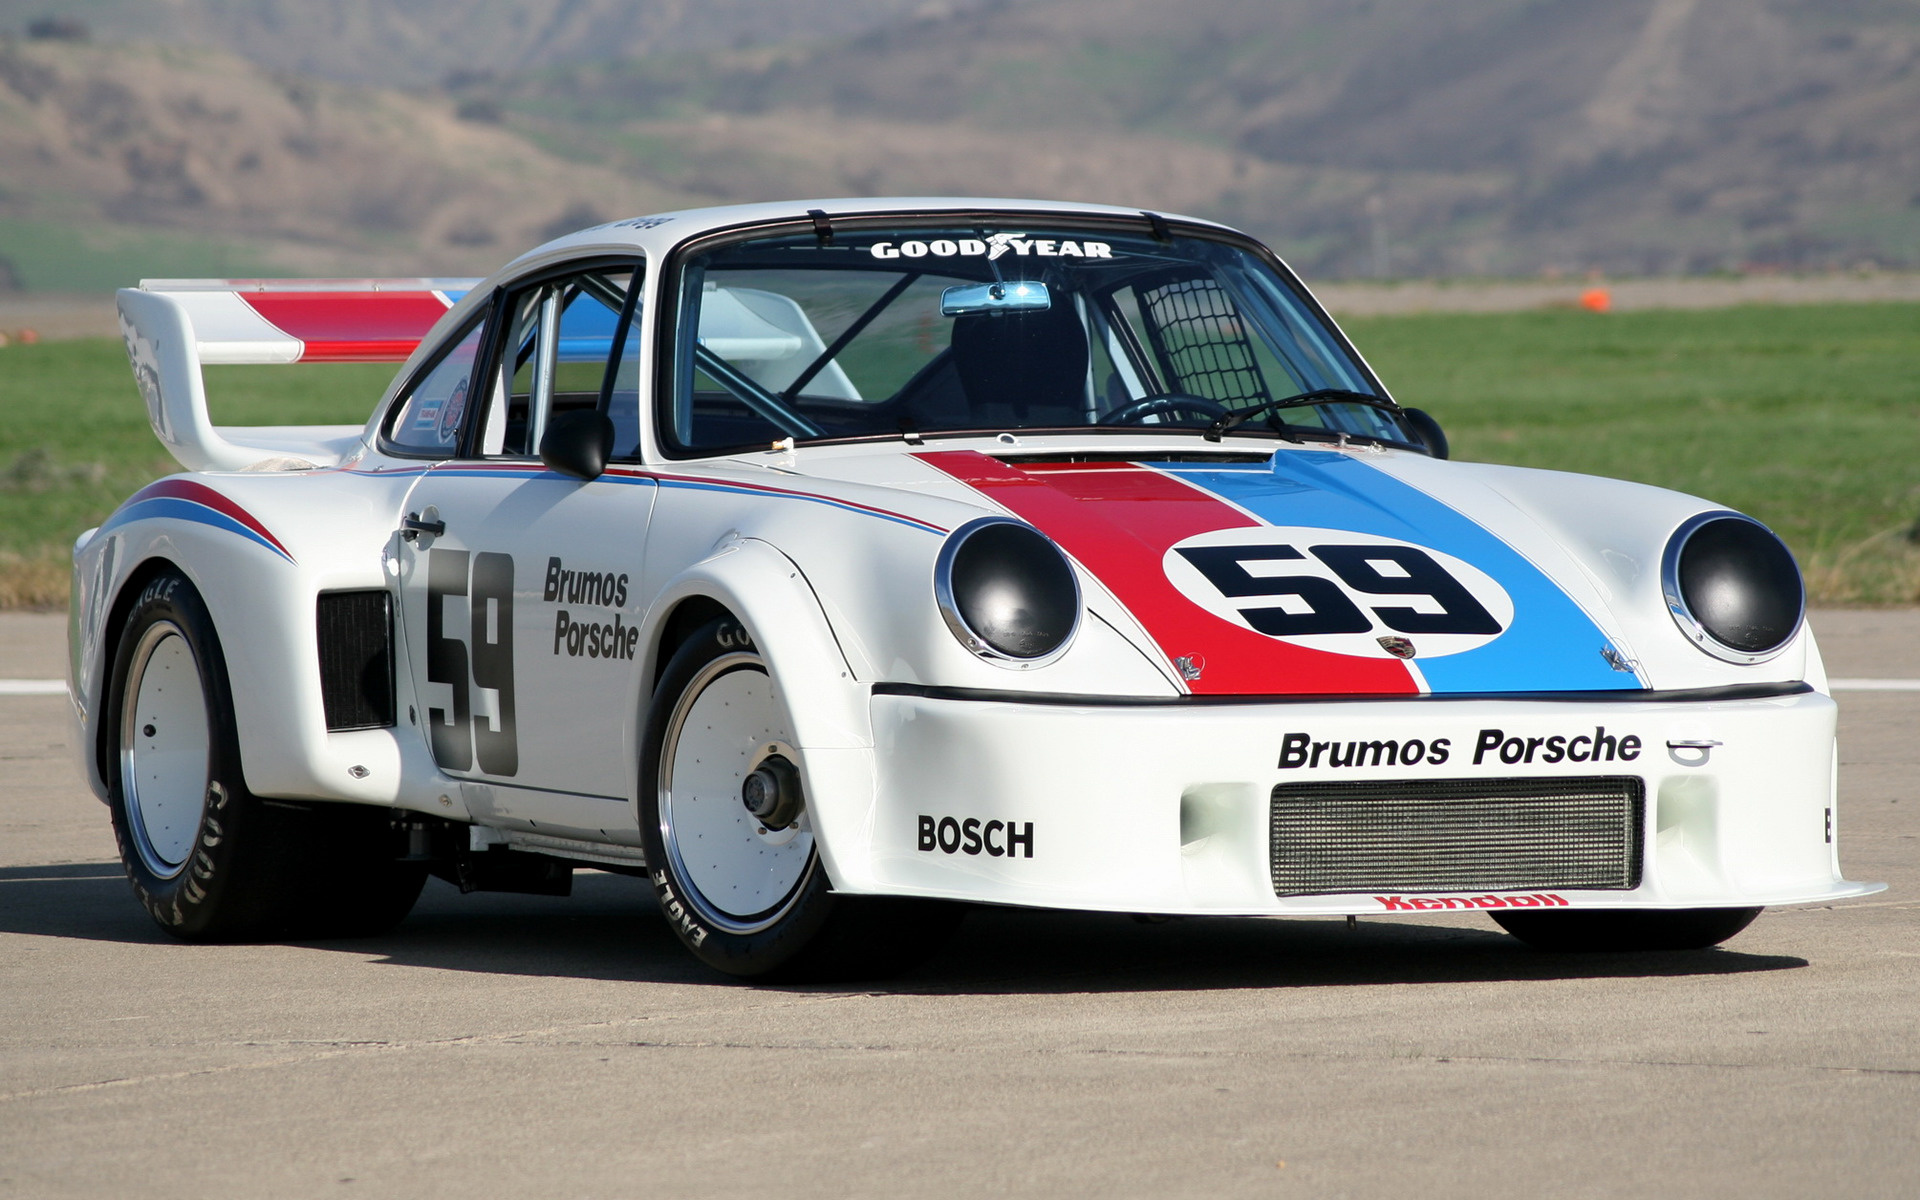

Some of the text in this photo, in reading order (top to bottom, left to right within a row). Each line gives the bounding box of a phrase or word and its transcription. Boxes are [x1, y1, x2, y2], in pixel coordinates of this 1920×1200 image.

[543, 556, 629, 608] Brumos
[1172, 544, 1503, 636] 59
[553, 610, 639, 661] Porsche
[426, 547, 519, 777] 59
[1277, 726, 1642, 769] Brumos Porsche
[917, 814, 1034, 859] BOSCH
[652, 868, 709, 948] EAGLE
[1373, 893, 1570, 911] Kendall
